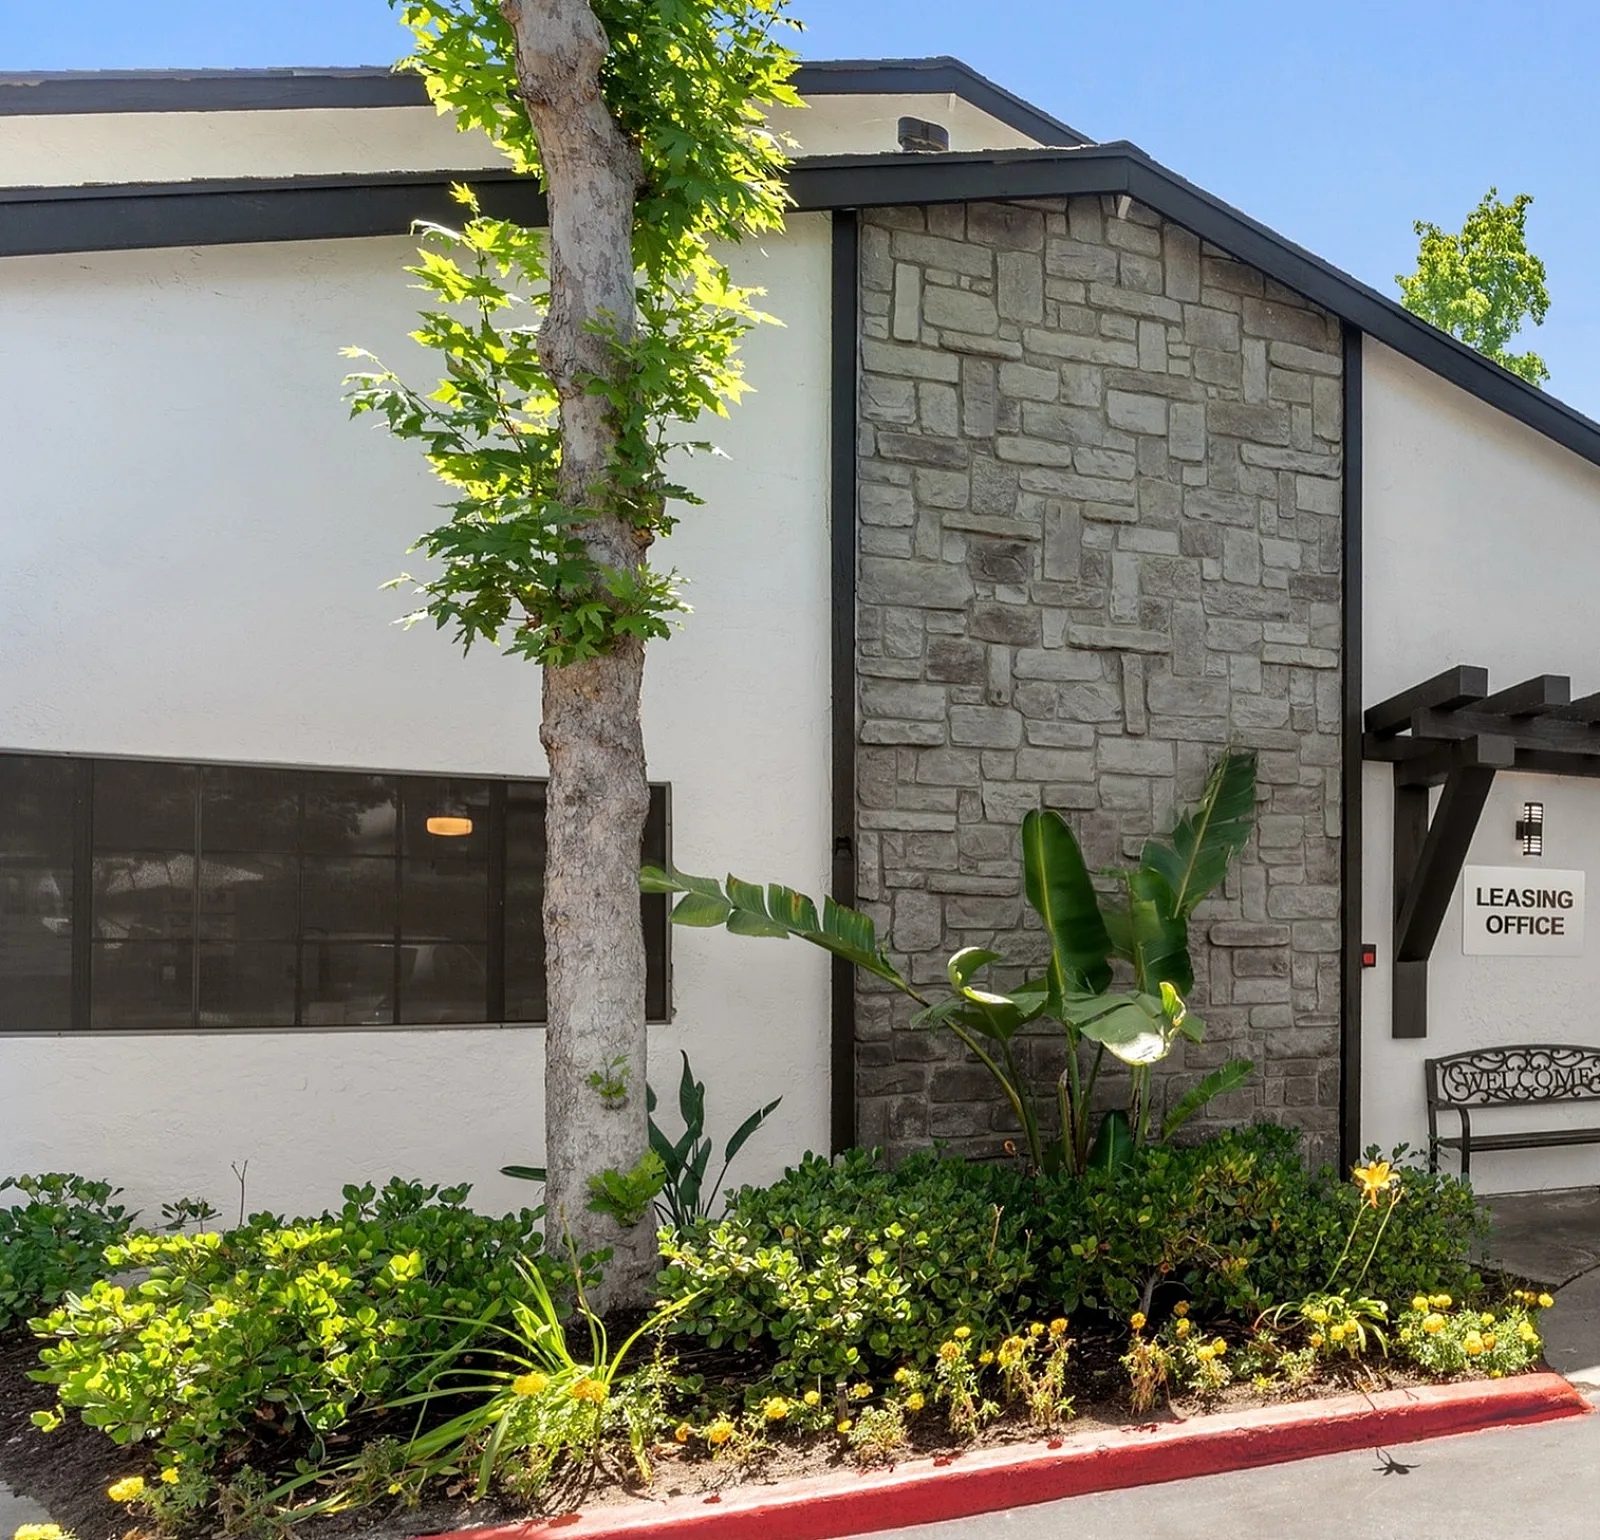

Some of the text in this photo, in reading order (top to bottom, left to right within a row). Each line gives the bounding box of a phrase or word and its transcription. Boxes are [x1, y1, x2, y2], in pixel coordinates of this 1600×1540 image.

[1476, 887, 1573, 909] LEASING
[1486, 915, 1564, 935] OFFICE
[1464, 1067, 1594, 1092] WELCOME
